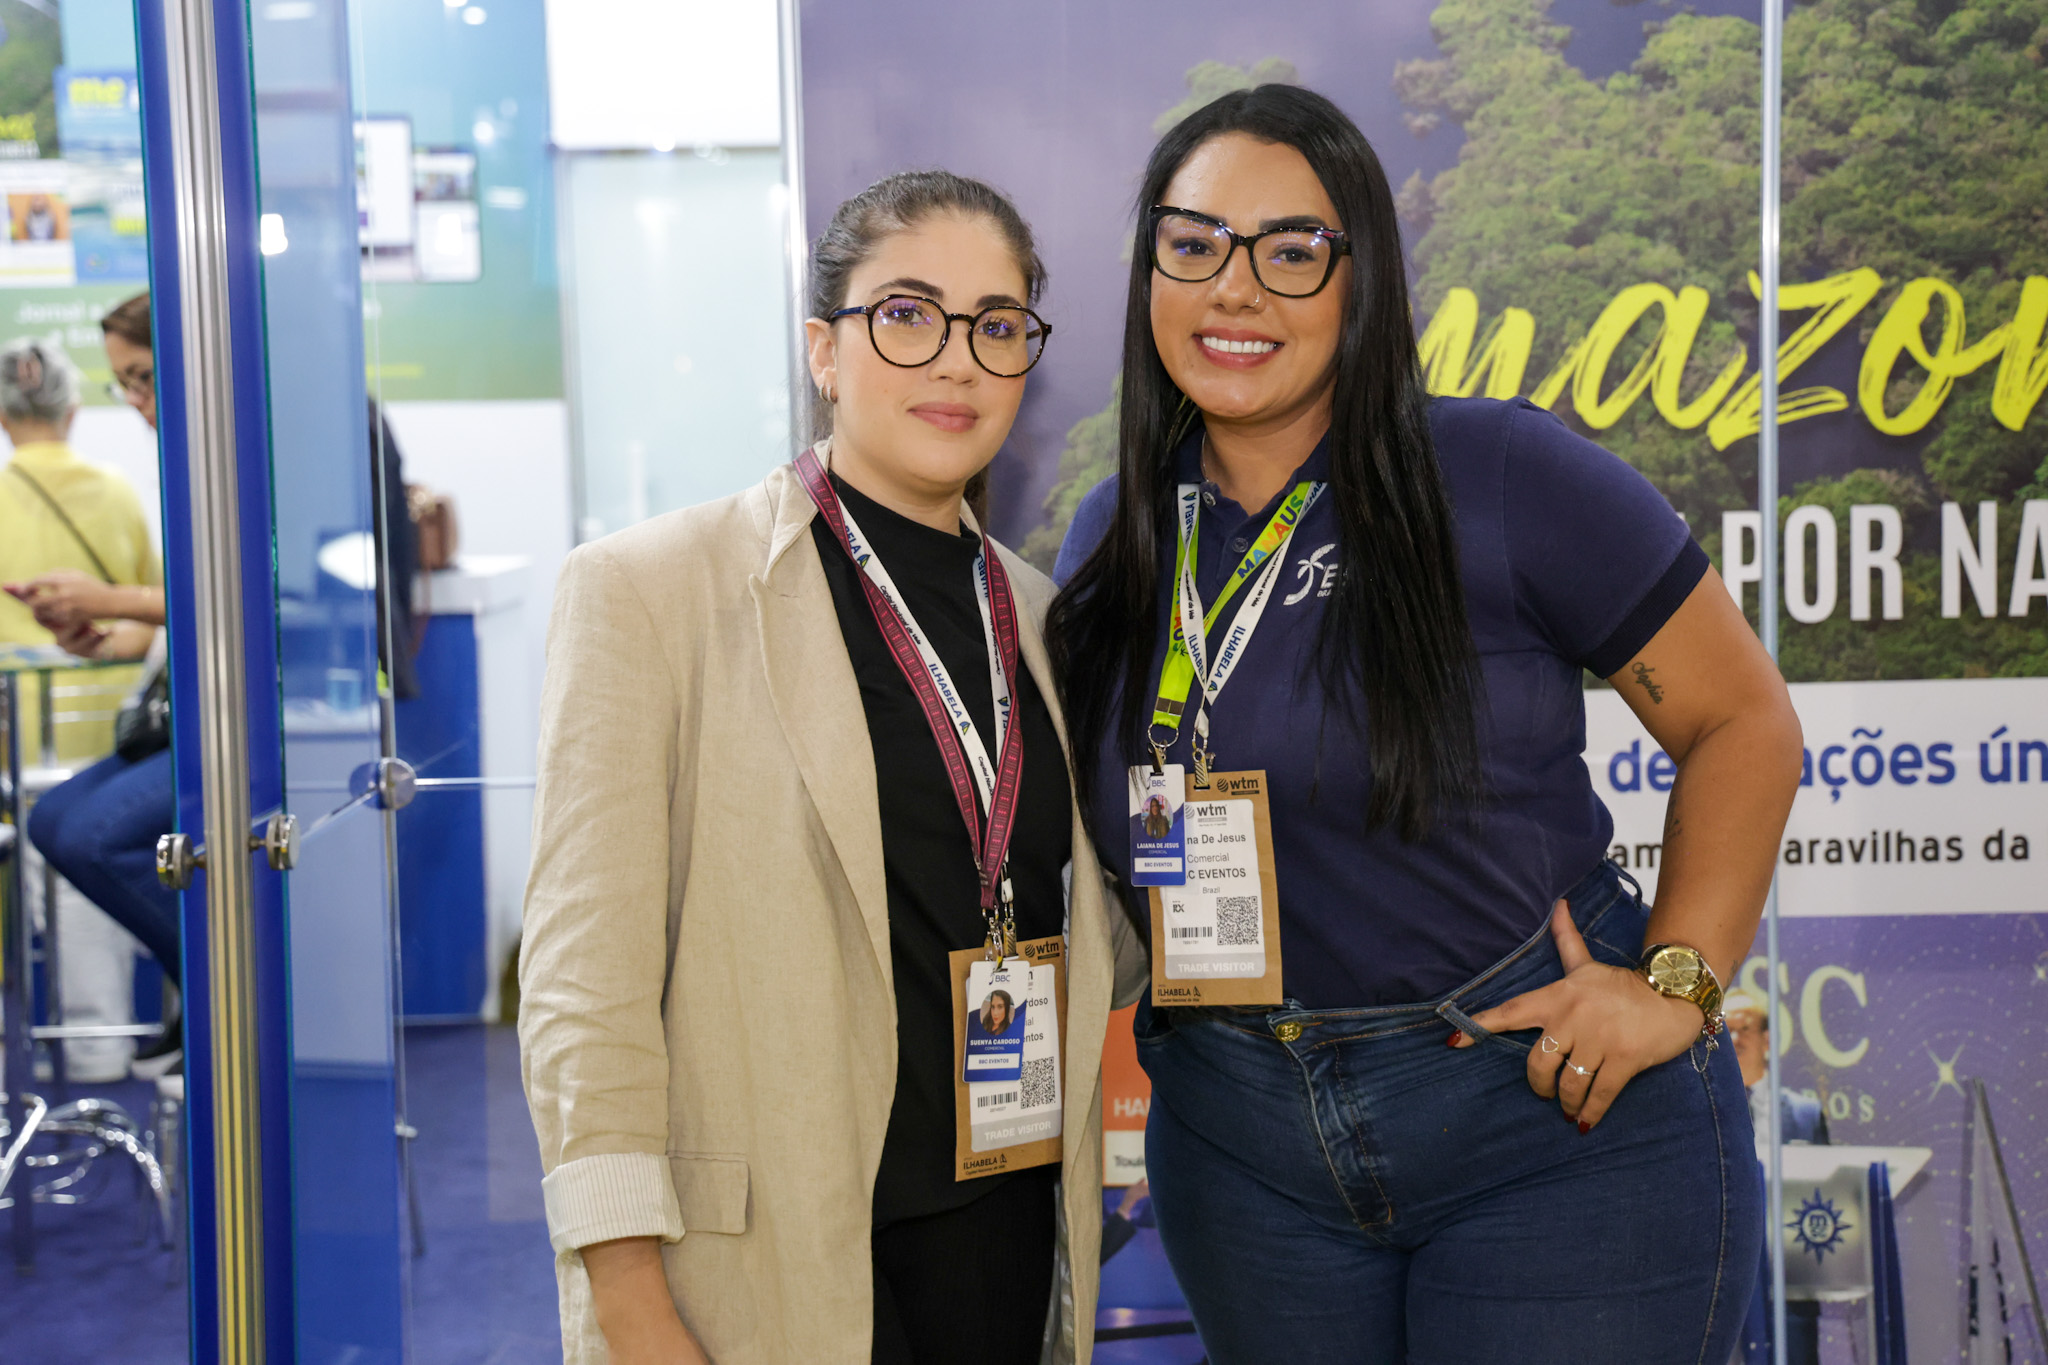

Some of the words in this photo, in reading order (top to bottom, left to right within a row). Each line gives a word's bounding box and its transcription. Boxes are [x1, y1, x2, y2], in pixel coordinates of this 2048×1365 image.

[1417, 266, 2048, 451] mazo
[1236, 495, 1304, 579] MANAUS
[1721, 503, 1904, 625] POR
[1214, 625, 1247, 679] ILHABELA
[928, 663, 963, 719] ILHABELA
[1230, 777, 1259, 789] wtm
[1197, 803, 1227, 817] wtm
[1201, 834, 1215, 844] De
[1217, 833, 1246, 843] Jesus
[1784, 829, 1964, 865] aravilhas
[1983, 828, 2030, 862] da
[1187, 853, 1230, 864] Comercial
[1198, 867, 1247, 879] EVENTOS
[1202, 886, 1221, 894] Brazil
[1036, 941, 1060, 954] wtm
[1178, 963, 1210, 973] TRADE
[1212, 961, 1255, 972] VISITOR
[1157, 988, 1191, 997] ILHABELA
[1026, 997, 1049, 1008] rdoso
[984, 1127, 1015, 1141] TRADE
[1018, 1121, 1052, 1135] VISITOR
[963, 1157, 998, 1170] ILHABELA
